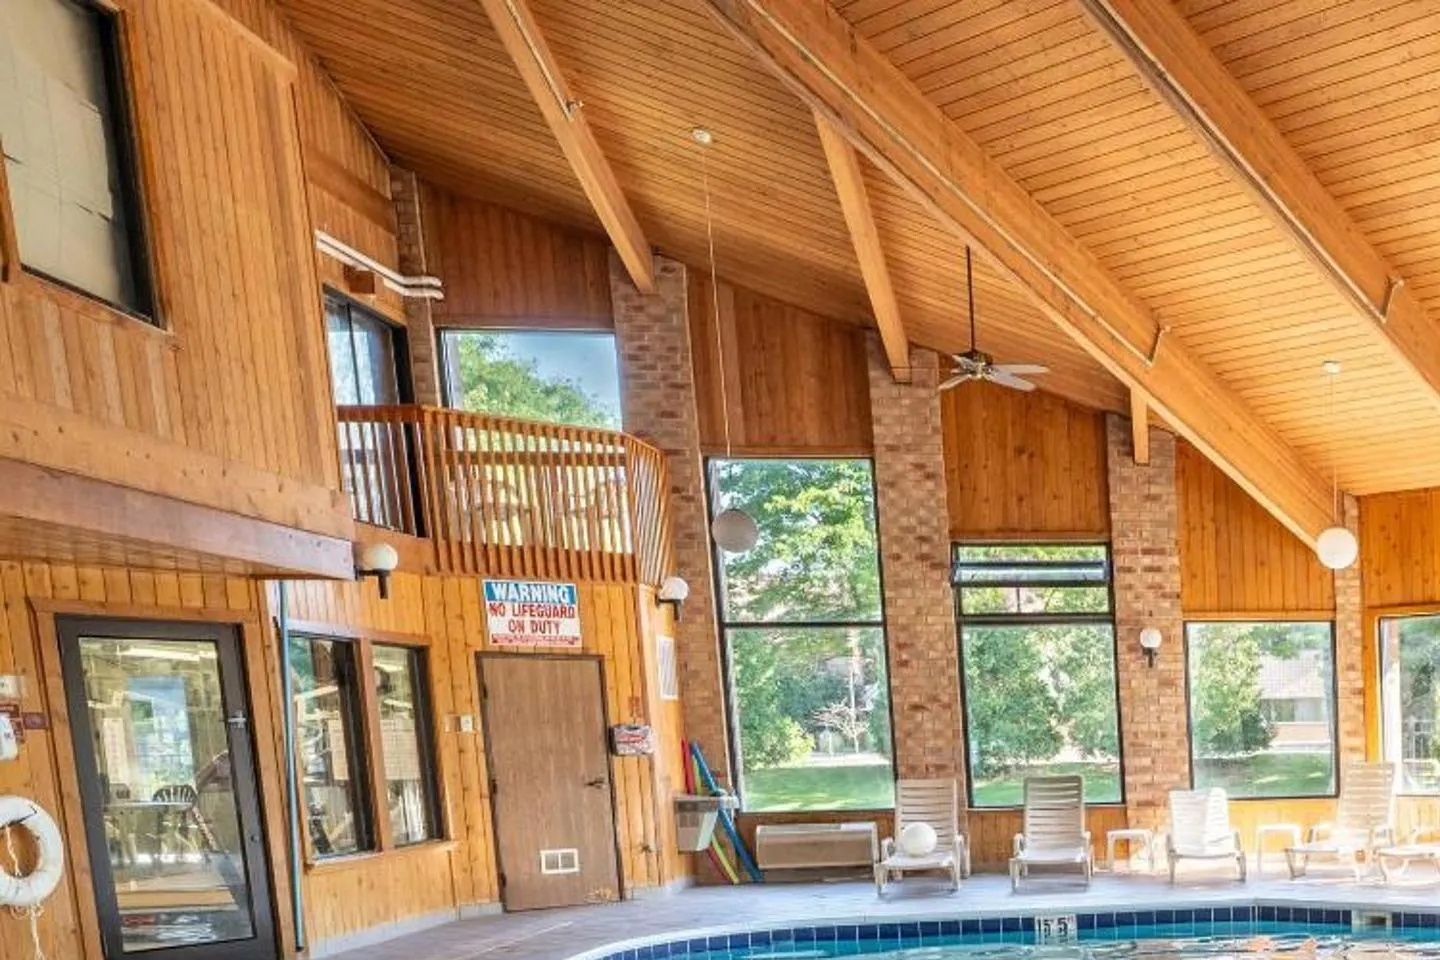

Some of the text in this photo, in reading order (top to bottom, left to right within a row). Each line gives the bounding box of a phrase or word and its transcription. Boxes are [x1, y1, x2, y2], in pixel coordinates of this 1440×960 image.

[491, 583, 571, 605] WARNING
[489, 602, 575, 619] NO LIFEGUARD
[508, 619, 560, 635] ON DUTY
